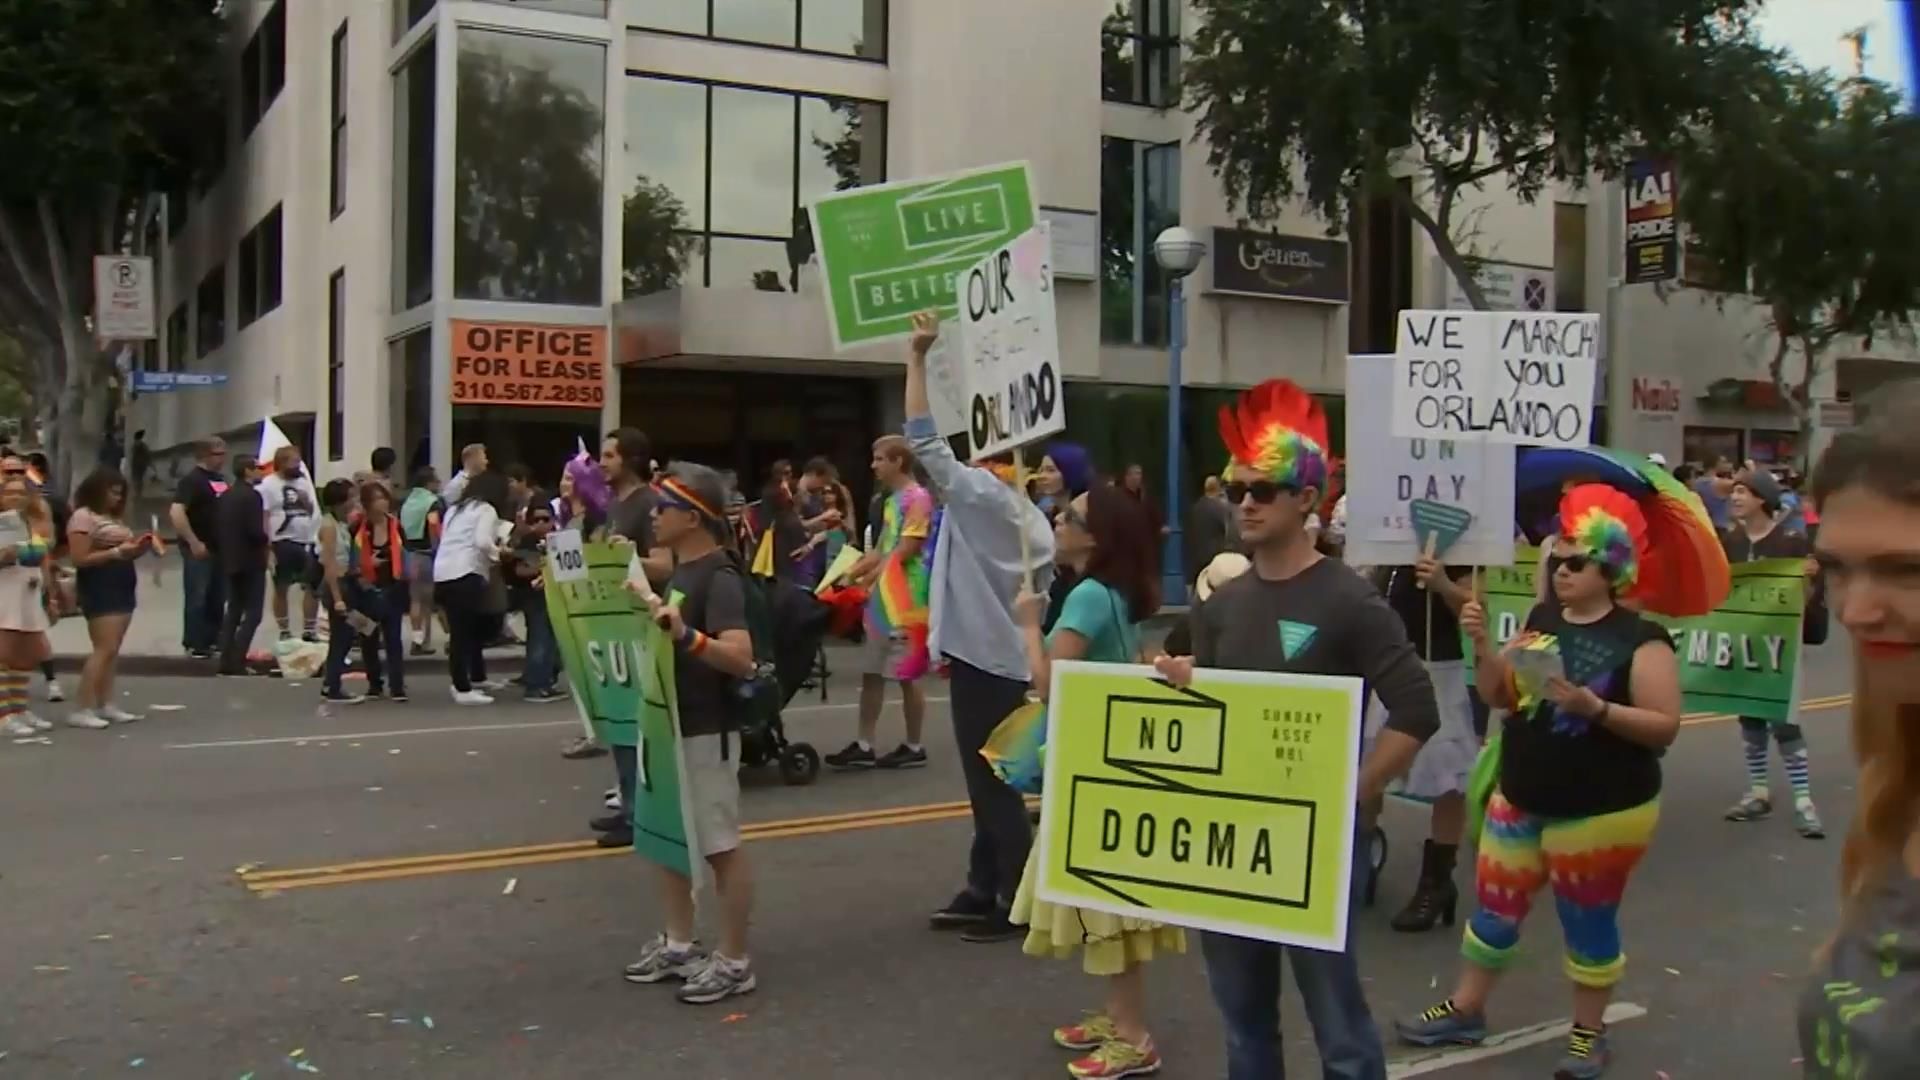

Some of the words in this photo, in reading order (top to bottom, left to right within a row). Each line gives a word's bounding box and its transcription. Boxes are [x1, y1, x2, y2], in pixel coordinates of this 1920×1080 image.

[923, 202, 986, 233] LIVE
[871, 270, 957, 306] BETTE
[968, 249, 1015, 322] OUR
[467, 327, 593, 356] OFFICE
[1406, 316, 1464, 349] WE
[1502, 318, 1598, 358] MARCH
[456, 356, 510, 376] FOR
[520, 359, 603, 380] LEASE
[1408, 358, 1464, 391] FOR
[971, 361, 1056, 451] ORLANDO
[1415, 395, 1582, 442] ORLANDO
[1398, 474, 1466, 501] DAY
[555, 549, 583, 571] 100
[1263, 707, 1323, 725] SUNDAY
[1139, 716, 1183, 753] NO
[1100, 808, 1273, 875] DOGMA
